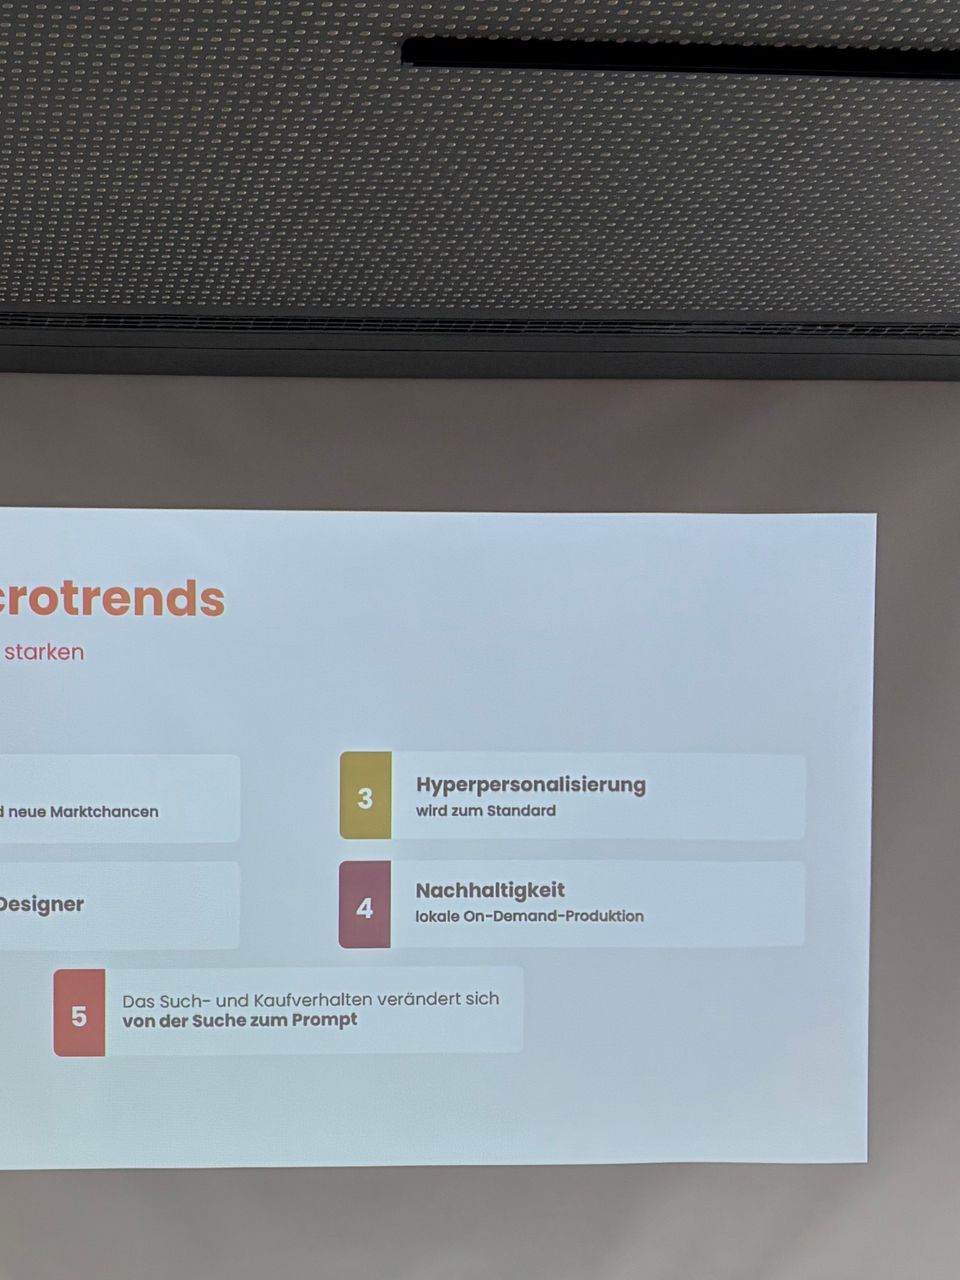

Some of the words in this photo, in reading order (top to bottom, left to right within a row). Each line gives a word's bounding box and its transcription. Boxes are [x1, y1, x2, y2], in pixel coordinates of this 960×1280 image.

[4, 642, 84, 661] starken
[416, 774, 646, 798] Hyperpersonalisierung
[357, 787, 373, 810] 3
[8, 807, 47, 818] neue
[50, 805, 159, 819] Marktchancen
[415, 803, 448, 817] wird
[451, 806, 484, 817] zum
[487, 803, 557, 817] Standard
[416, 880, 566, 904] Nachhaltigkeit
[355, 897, 374, 919] 4
[415, 909, 461, 923] lokale
[463, 909, 645, 923] On-Demand-Produktion
[122, 994, 155, 1009] Das
[159, 993, 211, 1009] Such-
[215, 993, 249, 1008] und
[254, 992, 373, 1008] Kaufverhalten
[376, 991, 462, 1007] verändert
[465, 990, 500, 1006] sich
[71, 1005, 87, 1027] 5
[122, 1016, 156, 1028] von
[158, 1013, 190, 1029] der
[191, 1012, 248, 1028] Suche
[249, 1015, 288, 1027] zum
[292, 1012, 358, 1031] Prompt
